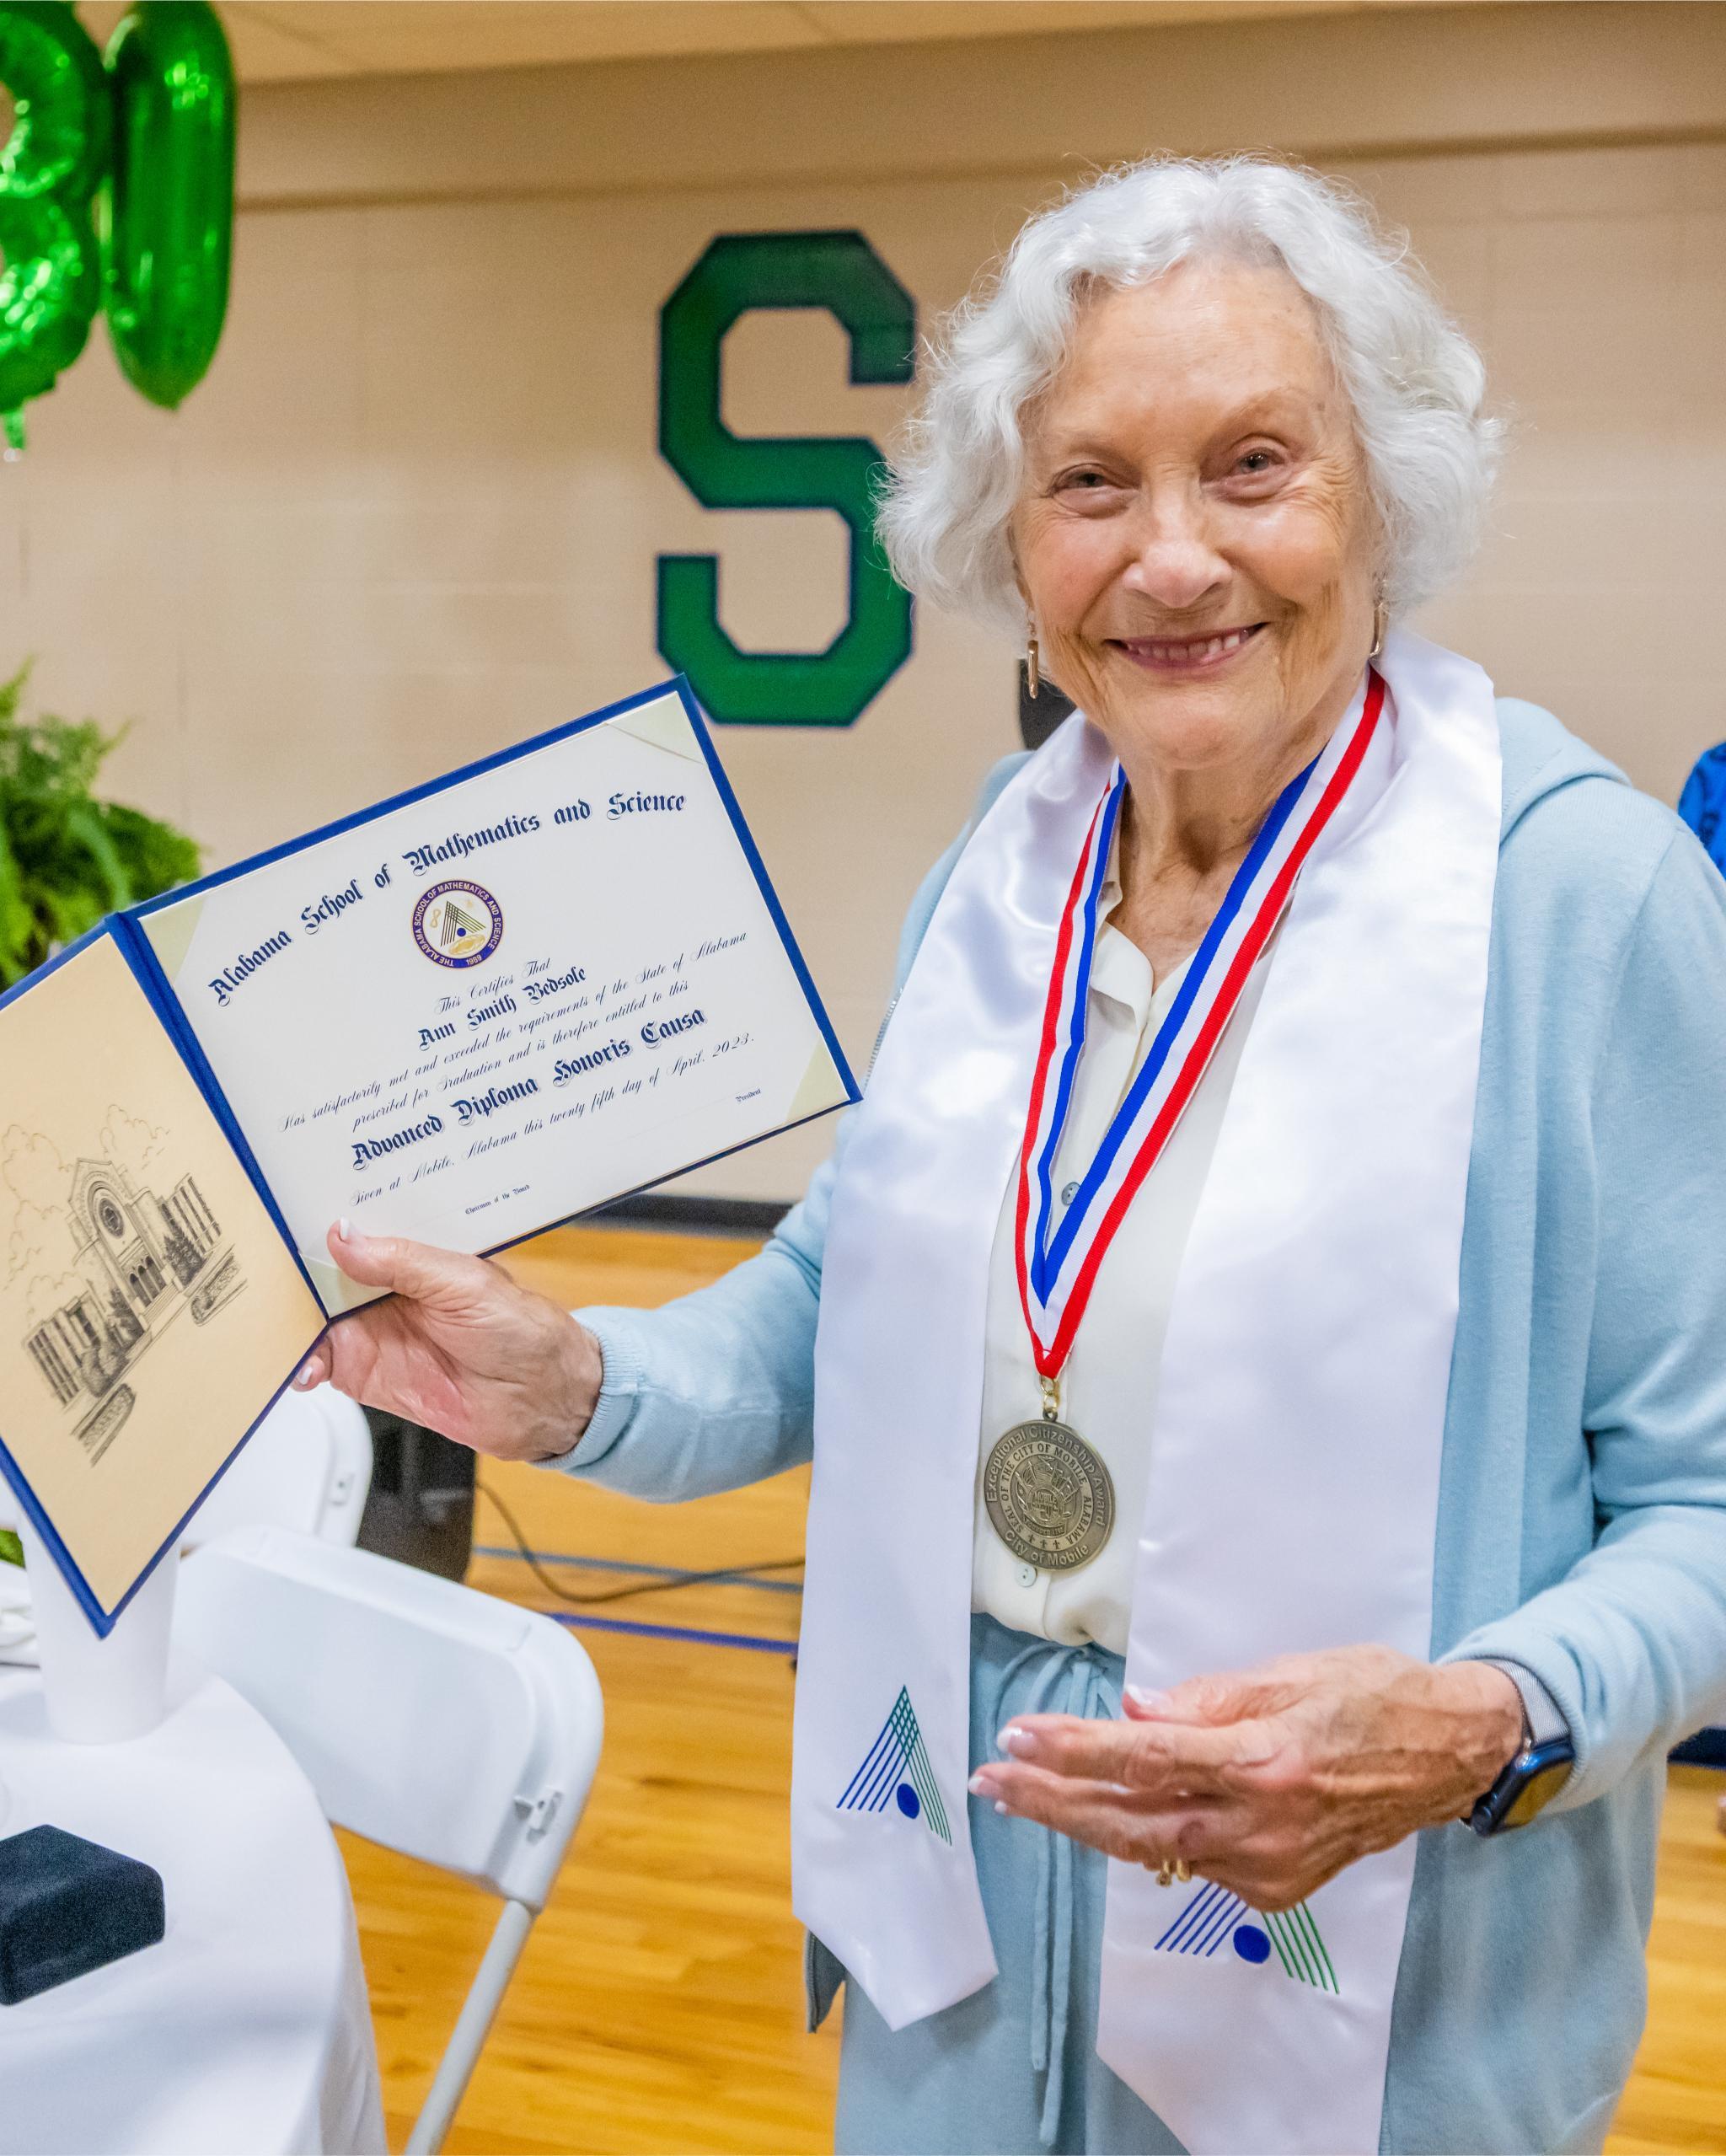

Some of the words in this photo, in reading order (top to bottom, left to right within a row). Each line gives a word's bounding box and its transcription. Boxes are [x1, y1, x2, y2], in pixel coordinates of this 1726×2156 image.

[656, 228, 916, 727] S
[207, 931, 292, 1007] Alabama
[300, 879, 364, 935] School
[374, 863, 391, 888] of
[401, 815, 541, 877] Mathematics
[554, 798, 592, 825] and
[607, 791, 686, 820] Science
[427, 888, 437, 899] OF
[437, 882, 490, 901] MATHEMATICS
[487, 900, 499, 915] AND
[415, 898, 430, 926] SCHOOL
[415, 928, 439, 960] ALABAMA
[487, 917, 501, 950] SCIENCE
[438, 957, 454, 967] THE
[433, 996, 461, 1015] This
[469, 974, 513, 999] Certifies
[522, 957, 550, 978] That
[417, 1022, 456, 1051] Ann
[467, 994, 517, 1031] Smith
[522, 966, 587, 1005] Bedsole
[278, 1114, 305, 1133] Has
[312, 1081, 381, 1118] satisfactorily
[389, 1069, 409, 1087] met
[415, 1055, 437, 1076] and
[443, 1032, 490, 1064] exceeded
[496, 1027, 512, 1043] the
[518, 996, 588, 1034] requirements
[595, 984, 606, 1006] of
[612, 979, 628, 995] the
[635, 963, 667, 984] State
[673, 952, 684, 973] of
[691, 931, 747, 961] Alabama
[353, 1093, 408, 1133] prescribed
[413, 1088, 429, 1108] for
[437, 1059, 501, 1091] Graduation
[508, 1042, 531, 1063] and
[537, 1039, 545, 1051] is
[552, 1018, 599, 1044] therefore
[606, 994, 646, 1023] entitled
[652, 991, 662, 1004] to
[669, 980, 689, 996] this
[351, 1114, 443, 1171] Advanced
[449, 1078, 539, 1126] Diploma
[552, 1038, 632, 1087] Honoris
[641, 1009, 706, 1049] Causa
[736, 1088, 761, 1102] President
[351, 1187, 383, 1206] Given
[389, 1177, 400, 1191] at
[462, 1130, 517, 1160] Alabama
[524, 1118, 543, 1134] this
[549, 1102, 585, 1124] twenty
[591, 1086, 614, 1113] fifth
[622, 1079, 642, 1095] day
[649, 1067, 660, 1086] of
[465, 1201, 491, 1215] Chairman
[1013, 1444, 1034, 1461] CITY
[1037, 1443, 1051, 1453] OF
[986, 1429, 1026, 1503] Exceptional
[1029, 1425, 1095, 1473] Citizenship
[1093, 1478, 1106, 1527] Award
[1002, 1461, 1016, 1483] THE
[1054, 1446, 1087, 1485] MOBILE
[1001, 1487, 1009, 1501] OF
[1005, 1506, 1022, 1533] SEAL
[1065, 1496, 1092, 1545] ALABAMA
[1005, 1530, 1028, 1556] City
[1031, 1552, 1045, 1563] of
[1047, 1544, 1089, 1566] Mobile
